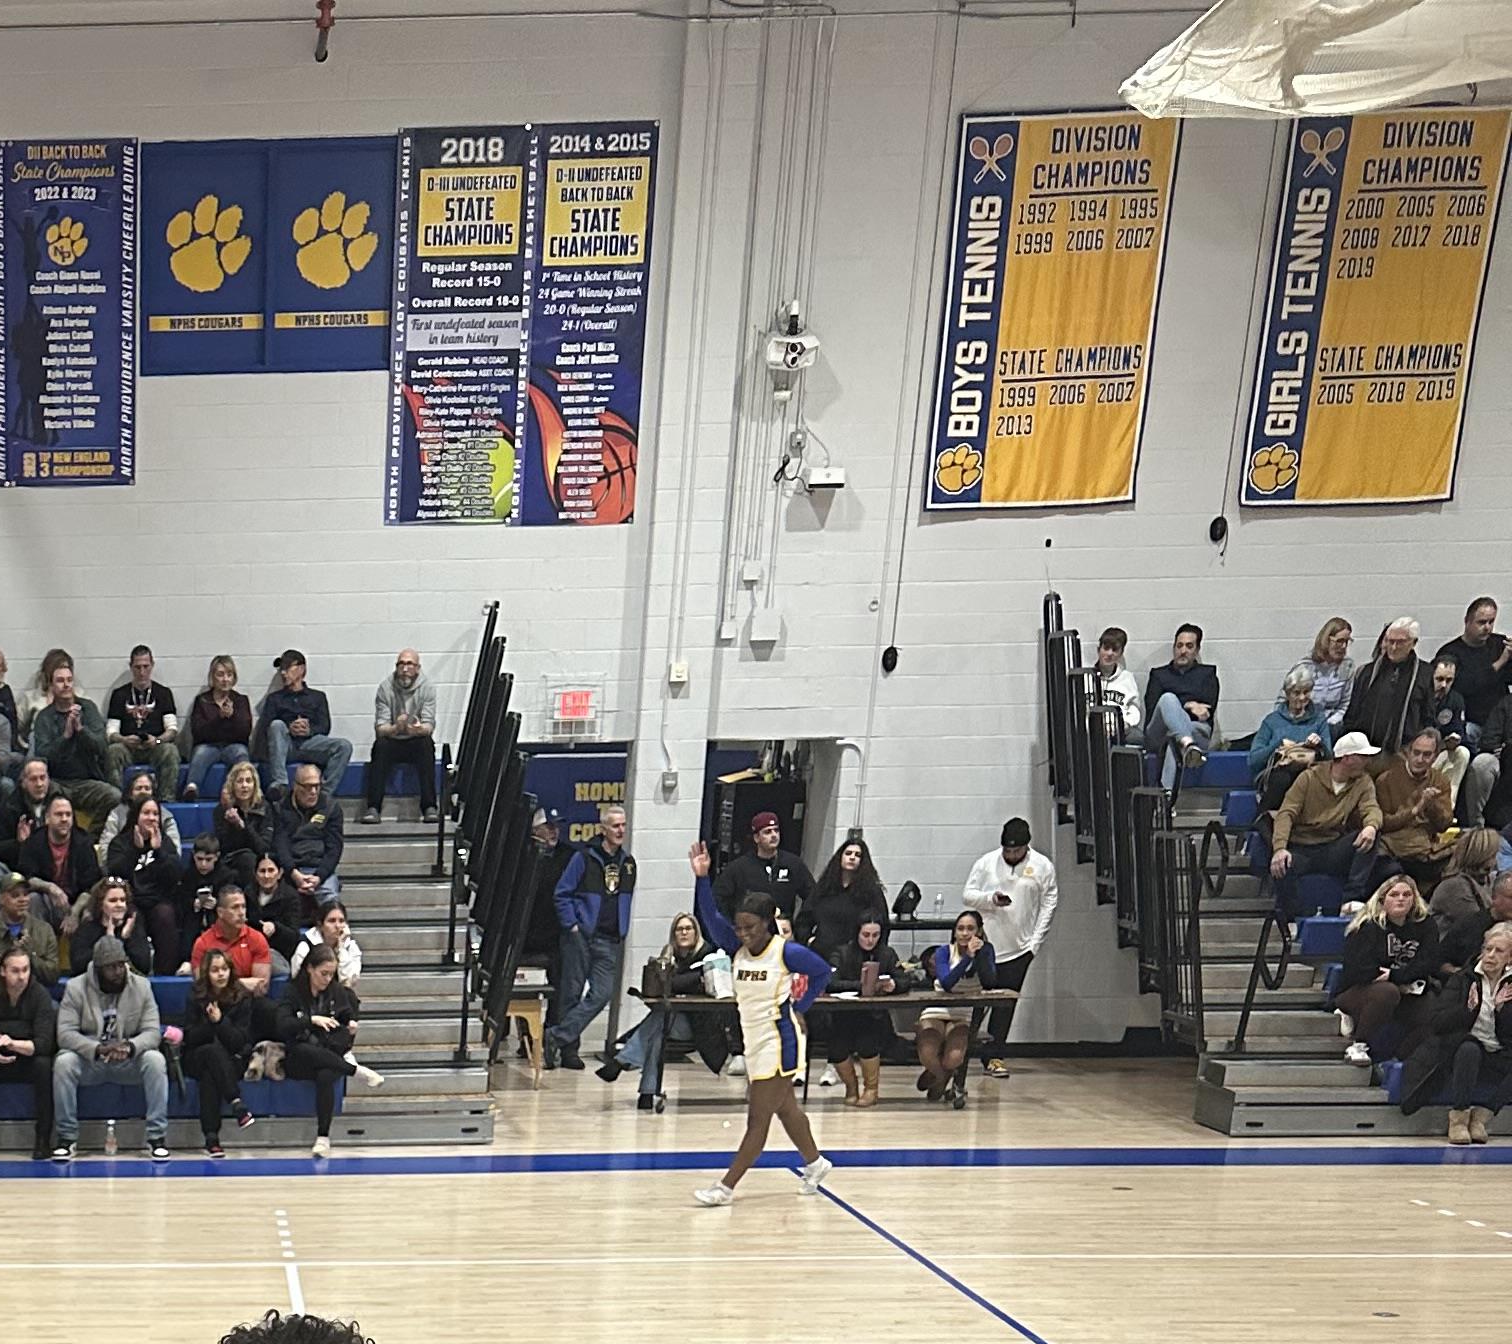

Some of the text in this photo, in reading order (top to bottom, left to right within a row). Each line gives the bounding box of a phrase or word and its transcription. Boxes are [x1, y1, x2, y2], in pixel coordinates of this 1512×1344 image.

[550, 132, 651, 153] 2014 & 2015
[1052, 124, 1142, 154] DIVISION
[1383, 120, 1474, 150] DIVISION
[43, 146, 66, 160] BACK
[68, 146, 80, 159] TO
[82, 145, 106, 159] BACK
[440, 136, 504, 164] 2018
[11, 162, 115, 182] State Champions
[556, 166, 642, 182] D-II UNDEFEATED
[1032, 160, 1152, 190] CHAMPIONS
[1362, 156, 1482, 185] CHAMPIONS
[34, 186, 60, 200] 2022
[72, 186, 96, 200] 2023
[428, 175, 517, 192] D-III UNDEFEATED
[561, 186, 634, 202] BACK TO BACK
[445, 197, 495, 222] STATE
[1018, 198, 1158, 224] 1992 1994 1995
[1346, 194, 1486, 220] 2000 2005 2006
[571, 208, 621, 233] STATE
[424, 224, 512, 246] CHAMPIONS
[1014, 227, 1155, 254] 1999 2006 2007
[1340, 224, 1481, 250] 2008 2017 2018
[550, 235, 638, 258] CHAMPIONS
[422, 260, 512, 274] Regular Season
[552, 272, 572, 282] Time
[573, 272, 582, 282] in
[584, 270, 610, 282] School
[613, 270, 644, 282] History
[1337, 257, 1374, 279] 2019
[432, 276, 502, 288] Record 15-0
[538, 286, 642, 300] 24 Game Winning Streak
[120, 145, 134, 476] NORTH PROVIDENCE VARSITY CHEERLEADING
[412, 296, 520, 308] Overall Record 18-0
[544, 302, 638, 317] 20-0 (Regular Season)
[1264, 186, 1330, 437] GIRLS TENNIS
[170, 316, 243, 330] NPHS COUGARS
[294, 313, 368, 326] NPHS COUGARS
[411, 318, 519, 332] First undefeated season
[511, 136, 538, 518] NORTH PROVIDENCE BOYS BASKETBALL
[948, 194, 1002, 438] BOYS TENNIS
[390, 136, 411, 520] NORTH PROVIDENCE LADY COUGARS TENNIS
[429, 332, 498, 346] in team history
[998, 344, 1142, 376] STATE CHAMPIONS
[1318, 344, 1463, 374] STATE CHAMPIONS
[998, 381, 1136, 408] 1999 2006 2007
[1317, 378, 1455, 404] 2005 2018 2019
[996, 415, 1032, 436] 2013
[39, 463, 50, 477] 3
[736, 969, 768, 982] NPHS
